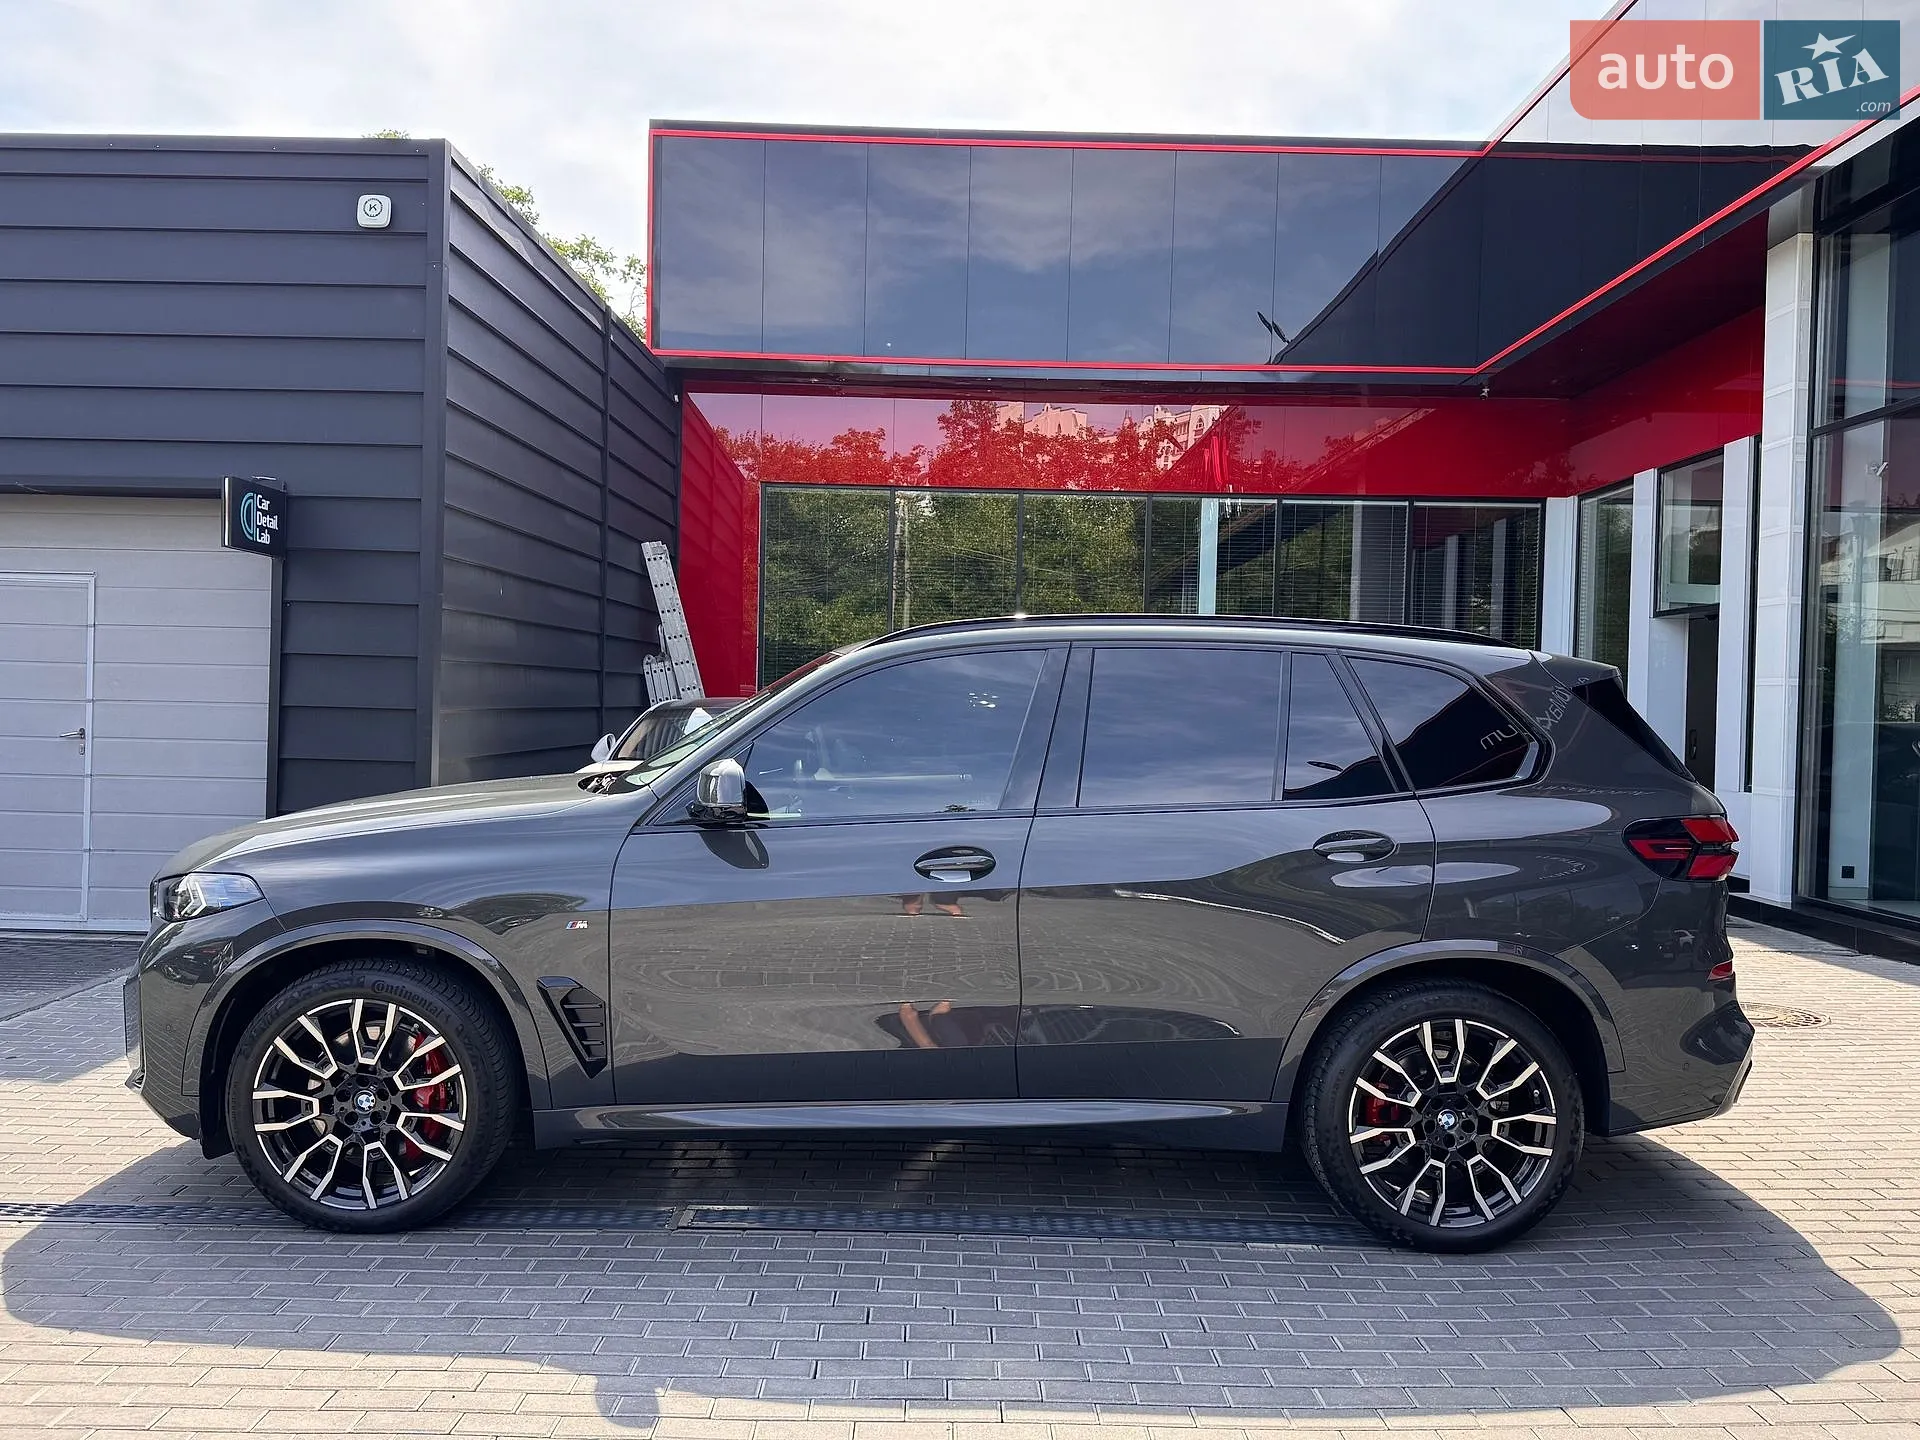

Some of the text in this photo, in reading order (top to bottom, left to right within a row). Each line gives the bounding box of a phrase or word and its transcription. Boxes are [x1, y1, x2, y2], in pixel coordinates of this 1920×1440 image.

[256, 494, 270, 511] Car
[256, 511, 278, 530] Detail
[256, 527, 270, 545] Lab
[370, 979, 443, 1018] Continental
